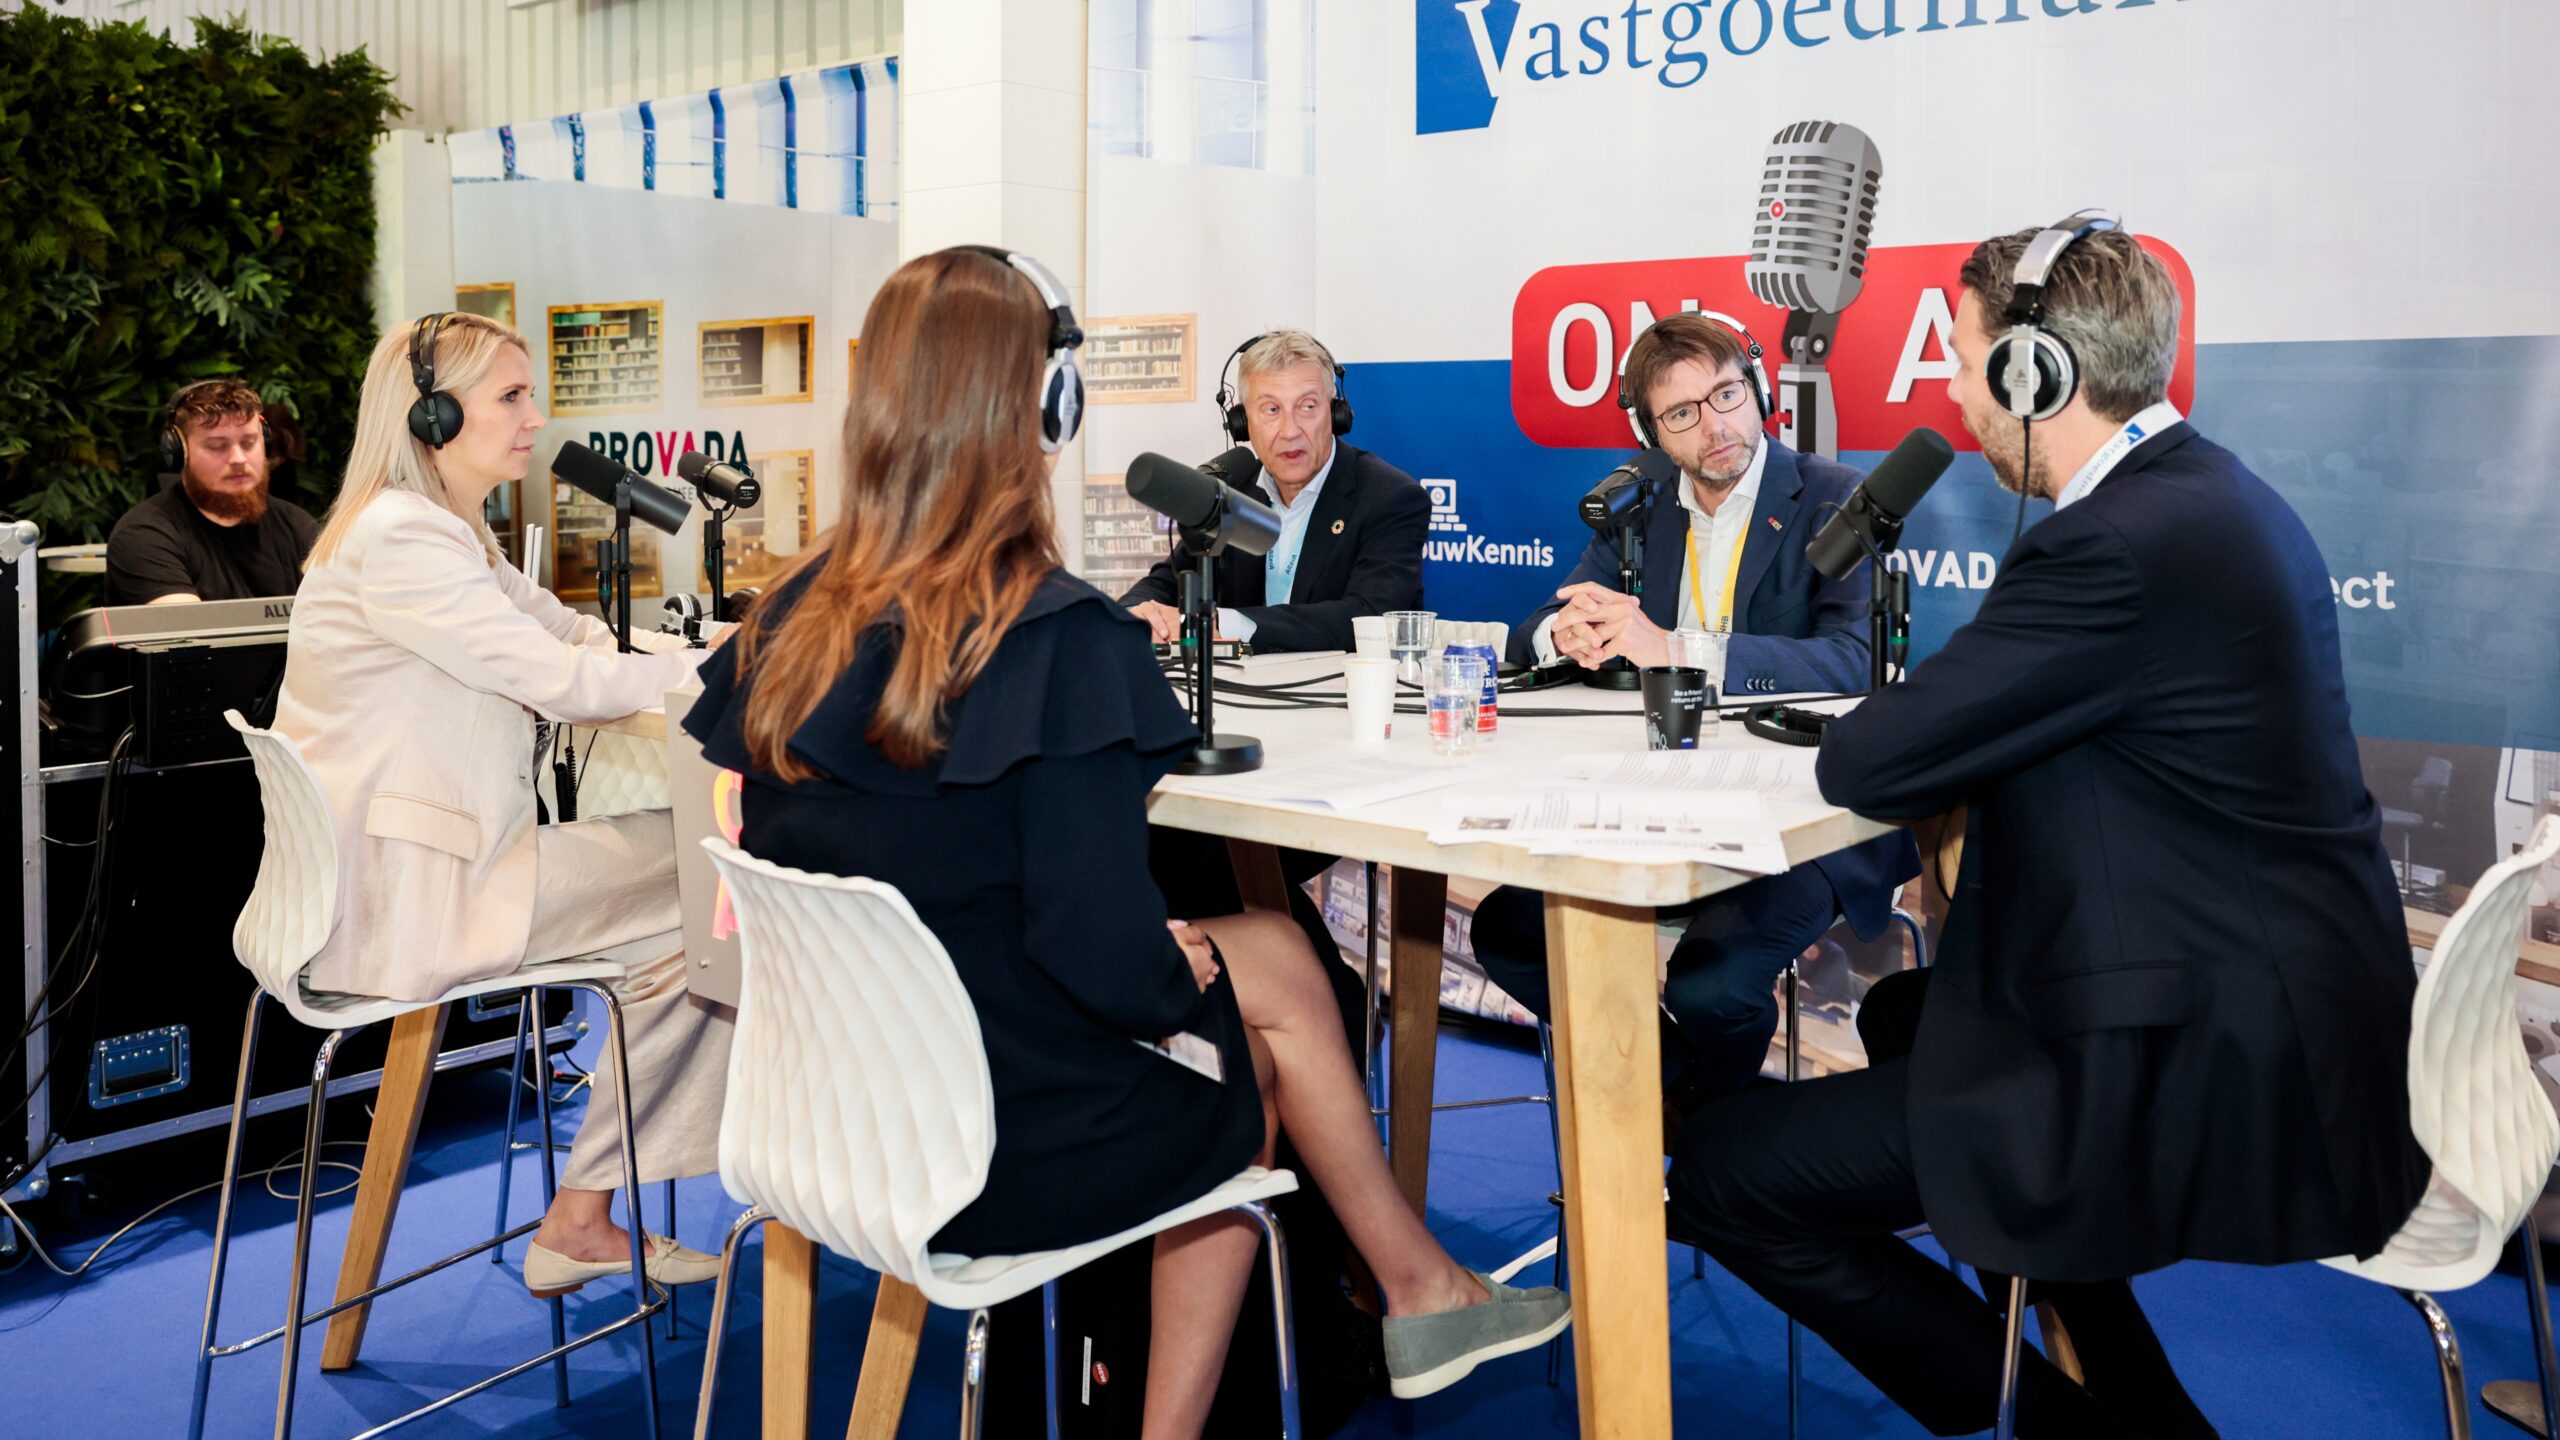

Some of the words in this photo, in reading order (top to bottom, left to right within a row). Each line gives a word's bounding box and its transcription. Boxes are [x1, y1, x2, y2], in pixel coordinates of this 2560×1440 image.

[1548, 299, 1698, 408] O
[1422, 534, 1554, 568] uwKennis
[264, 603, 294, 618] ALL
